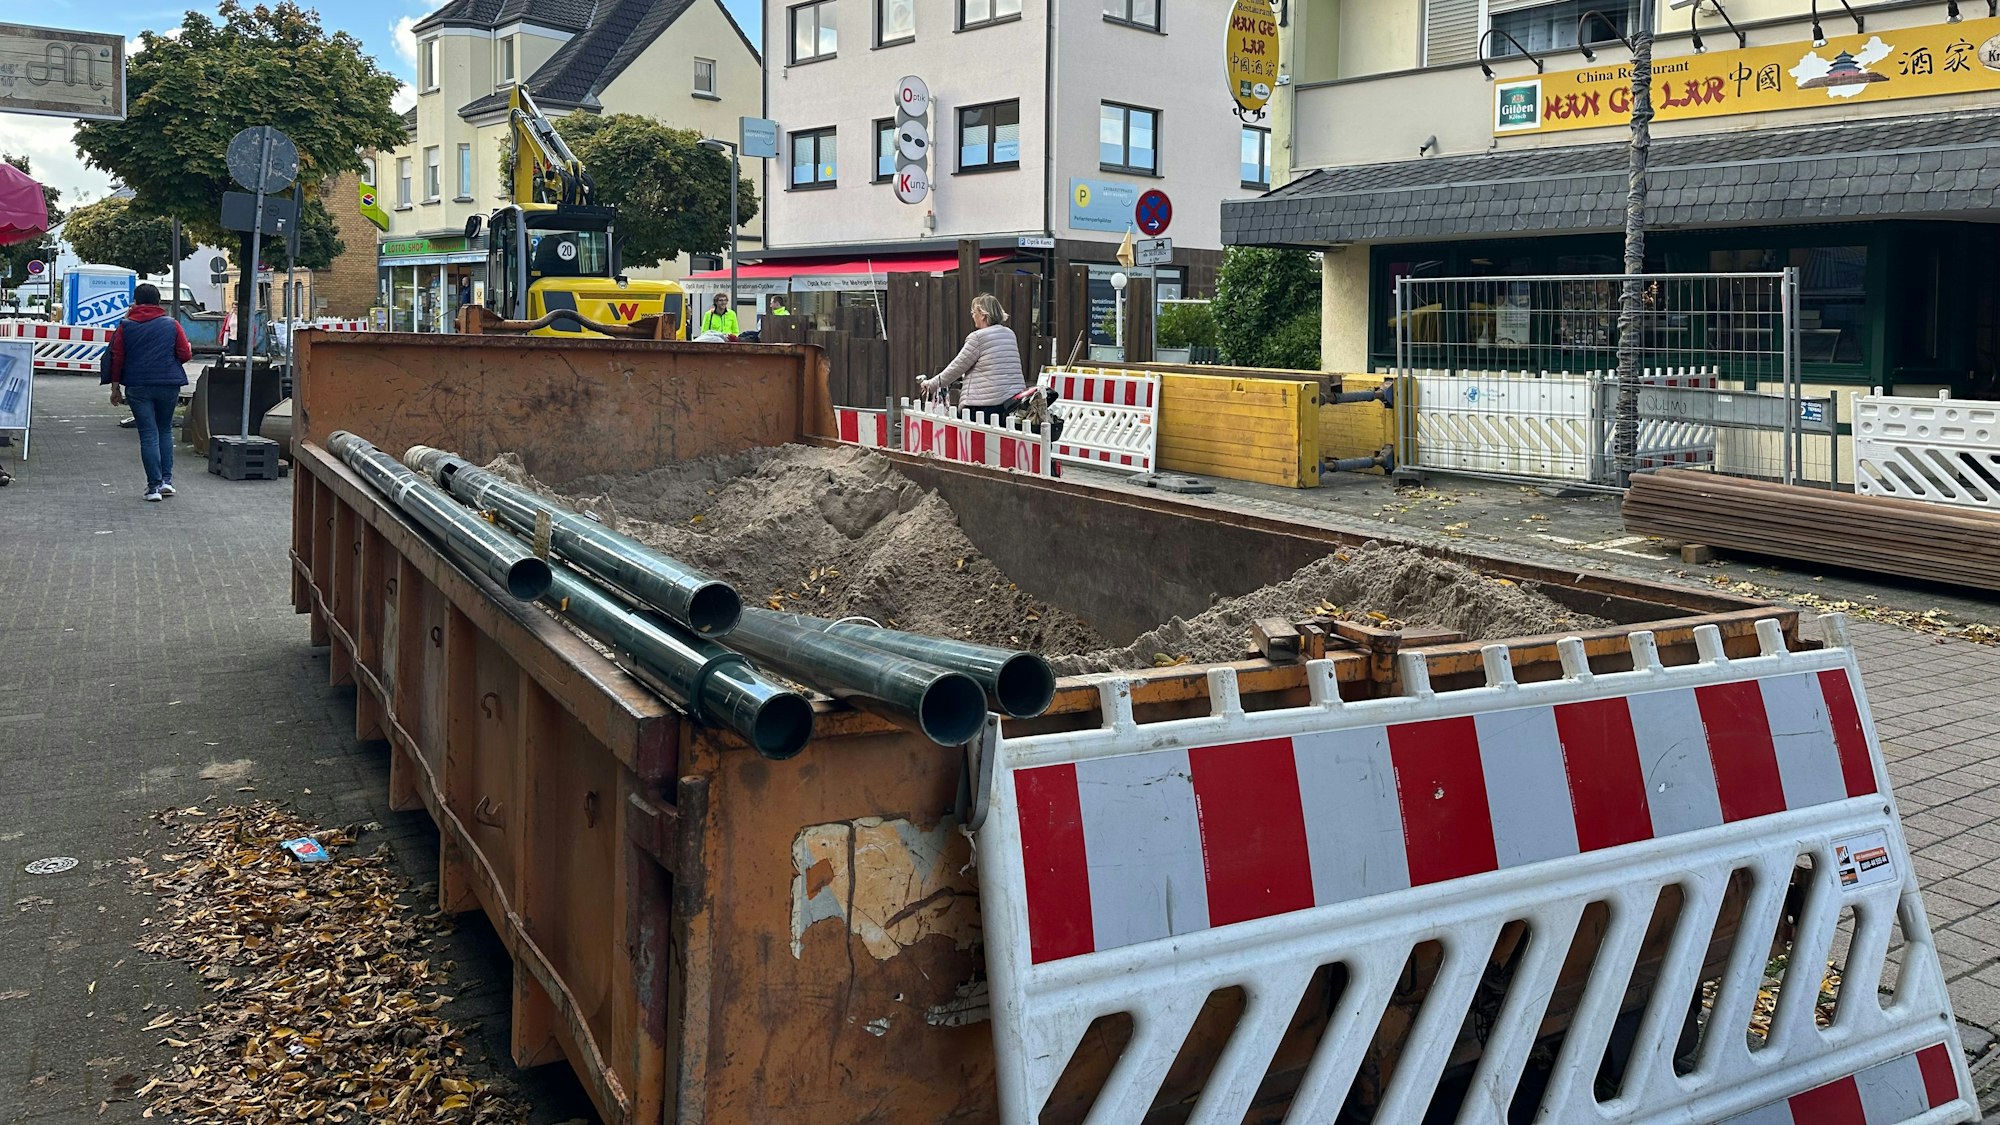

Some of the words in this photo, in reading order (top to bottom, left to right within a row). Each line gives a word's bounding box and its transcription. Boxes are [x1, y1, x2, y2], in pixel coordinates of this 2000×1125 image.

[1237, 3, 1272, 17] Restaurant
[1241, 36, 1266, 56] LAR
[1576, 71, 1614, 84] China
[1617, 60, 1690, 80] Reurant
[903, 88, 926, 102] Optik
[1543, 90, 1601, 121] HAN
[1659, 76, 1726, 110] LAR
[1501, 102, 1535, 116] Gilden
[900, 173, 925, 193] Kunz
[1080, 190, 1087, 202] P
[388, 243, 406, 253] LOTTO
[408, 242, 424, 252] SHOP
[561, 245, 572, 256] 20
